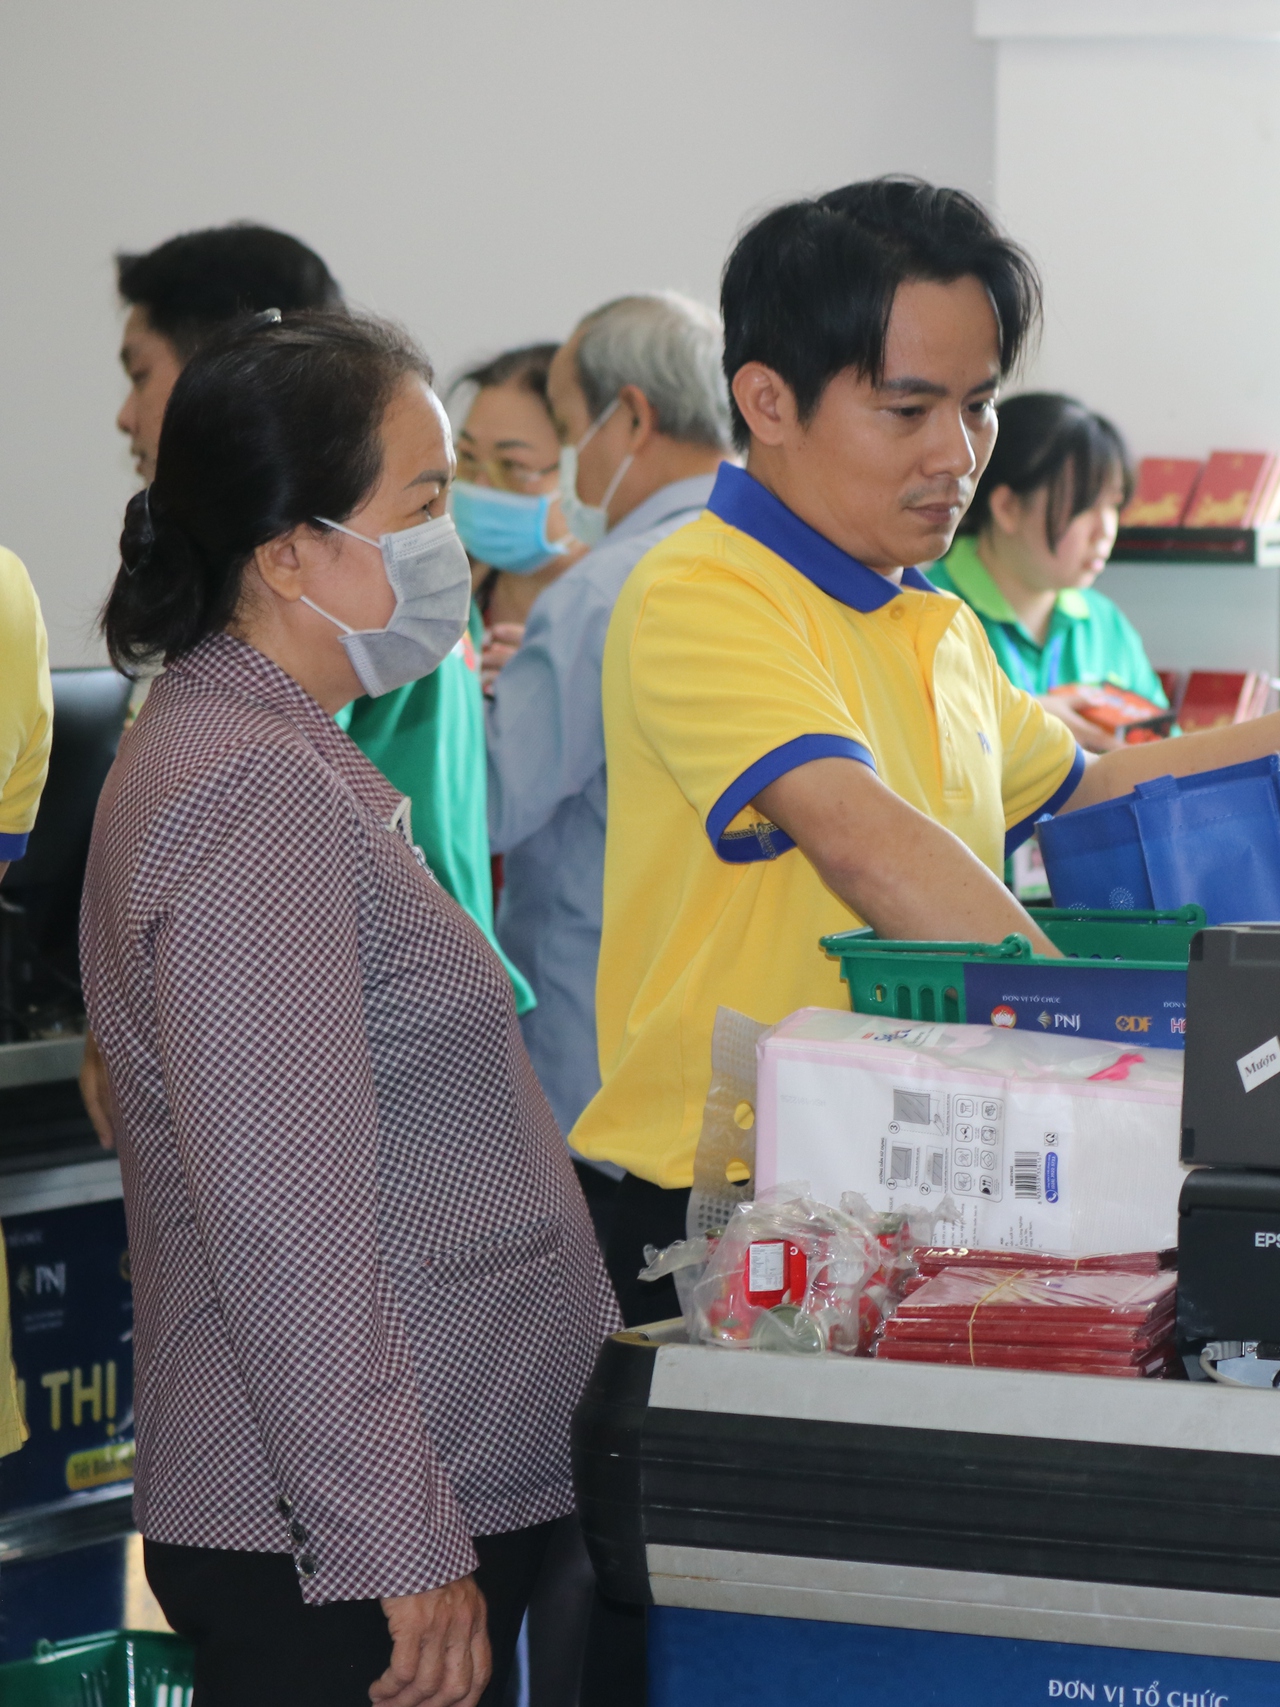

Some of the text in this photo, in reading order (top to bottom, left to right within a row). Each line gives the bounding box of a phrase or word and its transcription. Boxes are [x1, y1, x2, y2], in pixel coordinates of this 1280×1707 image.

[1054, 1013, 1081, 1032] PNJ
[1244, 1053, 1278, 1078] Mượn
[1048, 1679, 1096, 1702] ĐƠN
[1102, 1685, 1125, 1707] VỊ
[1132, 1680, 1161, 1707] TỔ
